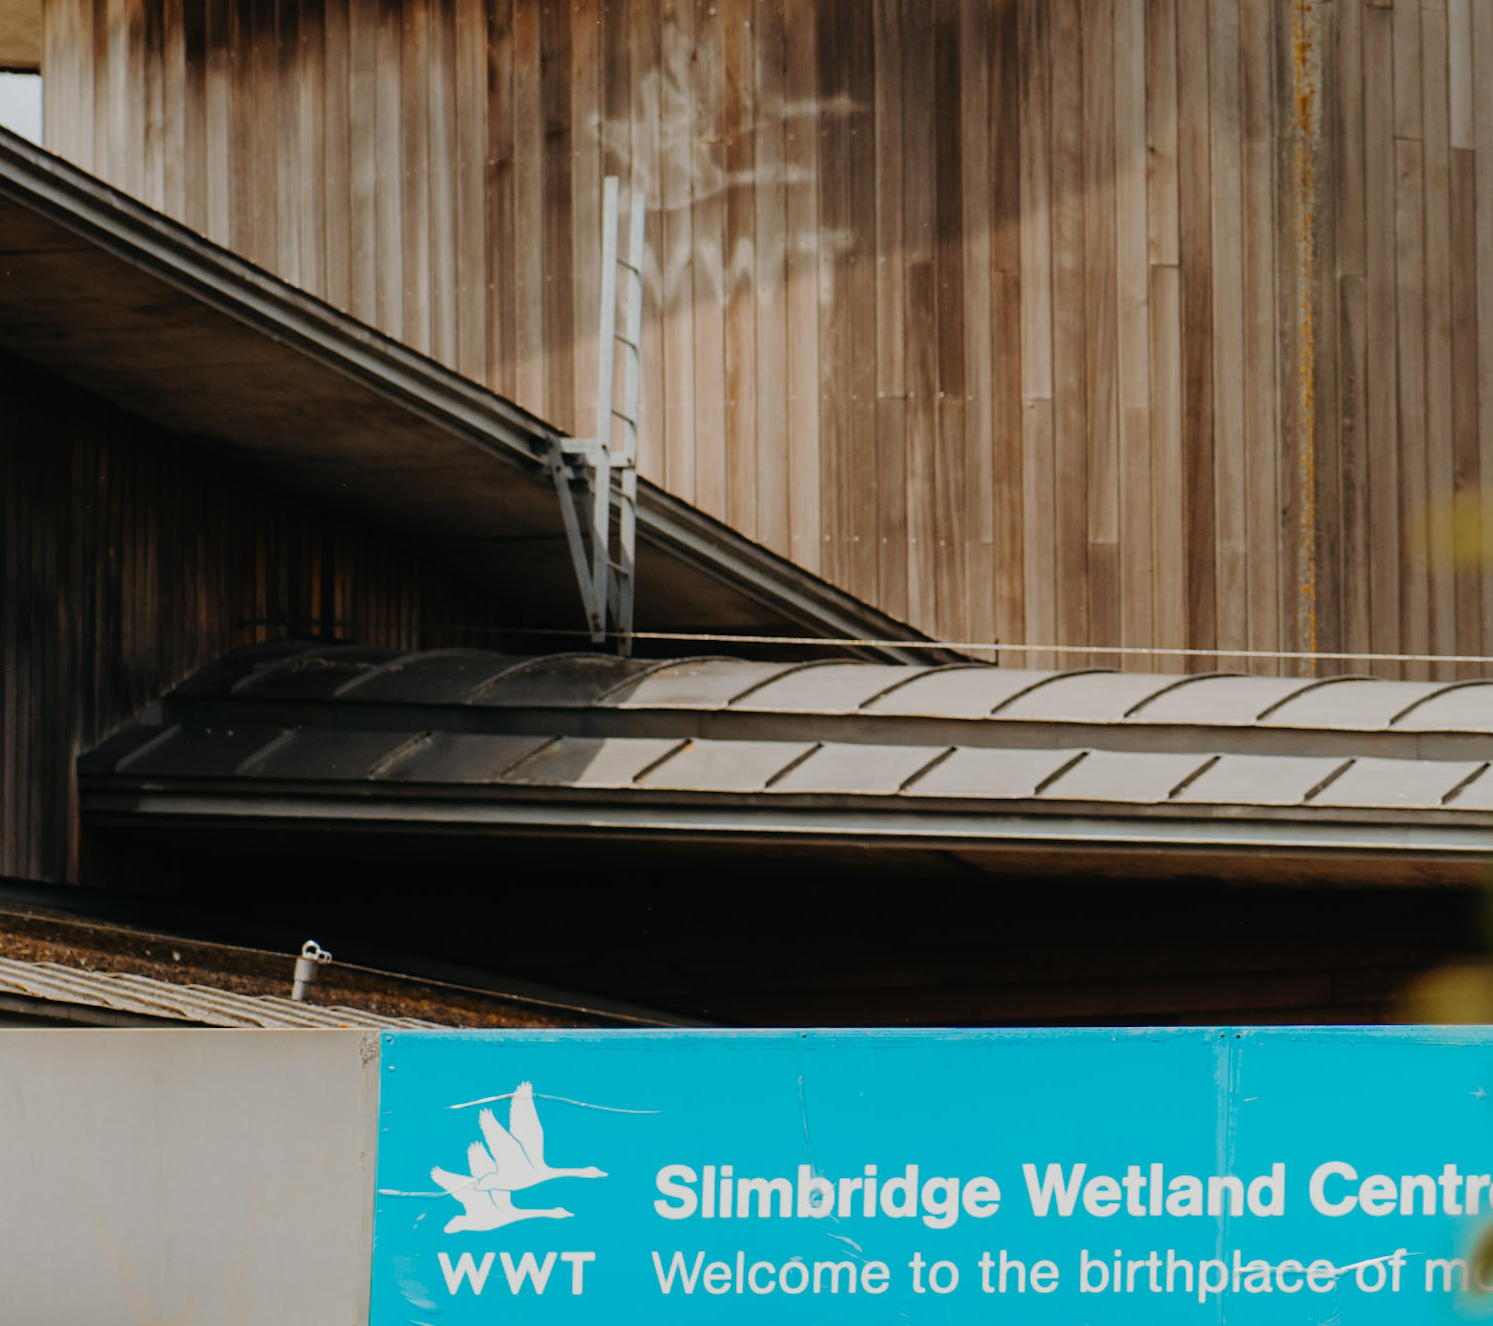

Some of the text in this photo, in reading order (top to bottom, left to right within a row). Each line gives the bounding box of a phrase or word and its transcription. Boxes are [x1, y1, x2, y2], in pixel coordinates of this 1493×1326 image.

[653, 1163, 1002, 1230] Slimbridge
[1022, 1162, 1286, 1218] Wetland
[437, 1251, 596, 1296] WWT
[651, 1250, 891, 1295] Welcome
[908, 1251, 960, 1294] to
[977, 1249, 1060, 1294] the
[1079, 1248, 1336, 1304] birthplace
[1354, 1248, 1407, 1293] of
